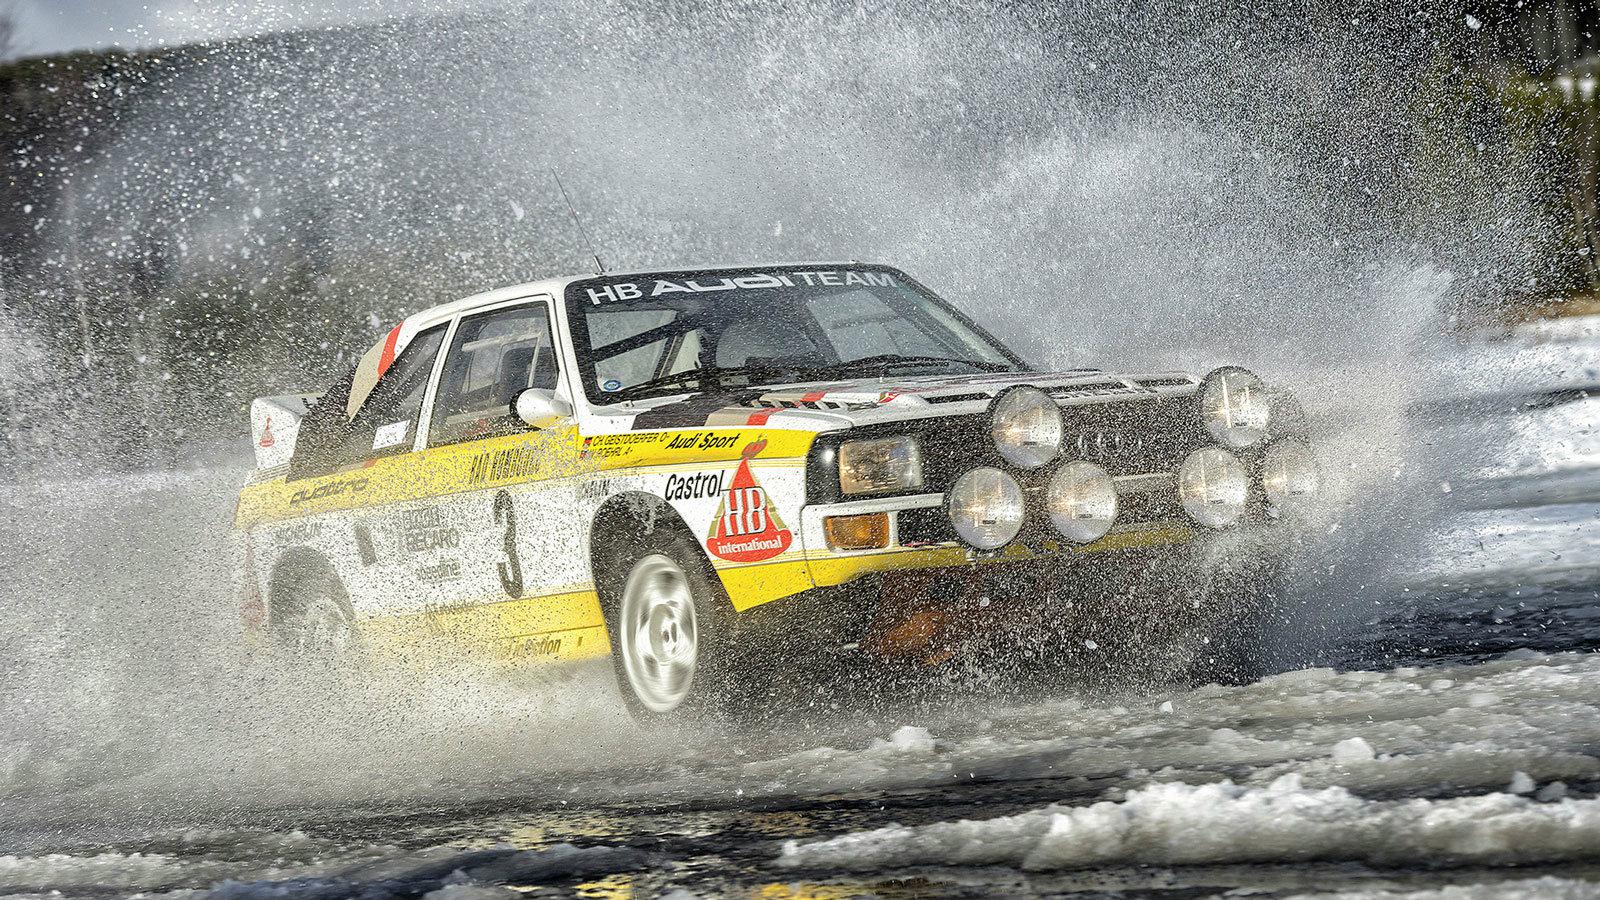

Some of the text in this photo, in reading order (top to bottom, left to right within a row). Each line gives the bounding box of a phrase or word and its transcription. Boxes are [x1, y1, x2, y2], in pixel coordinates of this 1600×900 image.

[586, 283, 643, 305] HB
[793, 271, 899, 288] TEAM
[665, 432, 741, 450] Audi Sport
[289, 478, 370, 505] quattro
[665, 470, 725, 501] Castrol
[721, 486, 768, 537] HB
[405, 527, 461, 552] RECARO
[494, 488, 524, 599] 3
[717, 536, 783, 555] international
